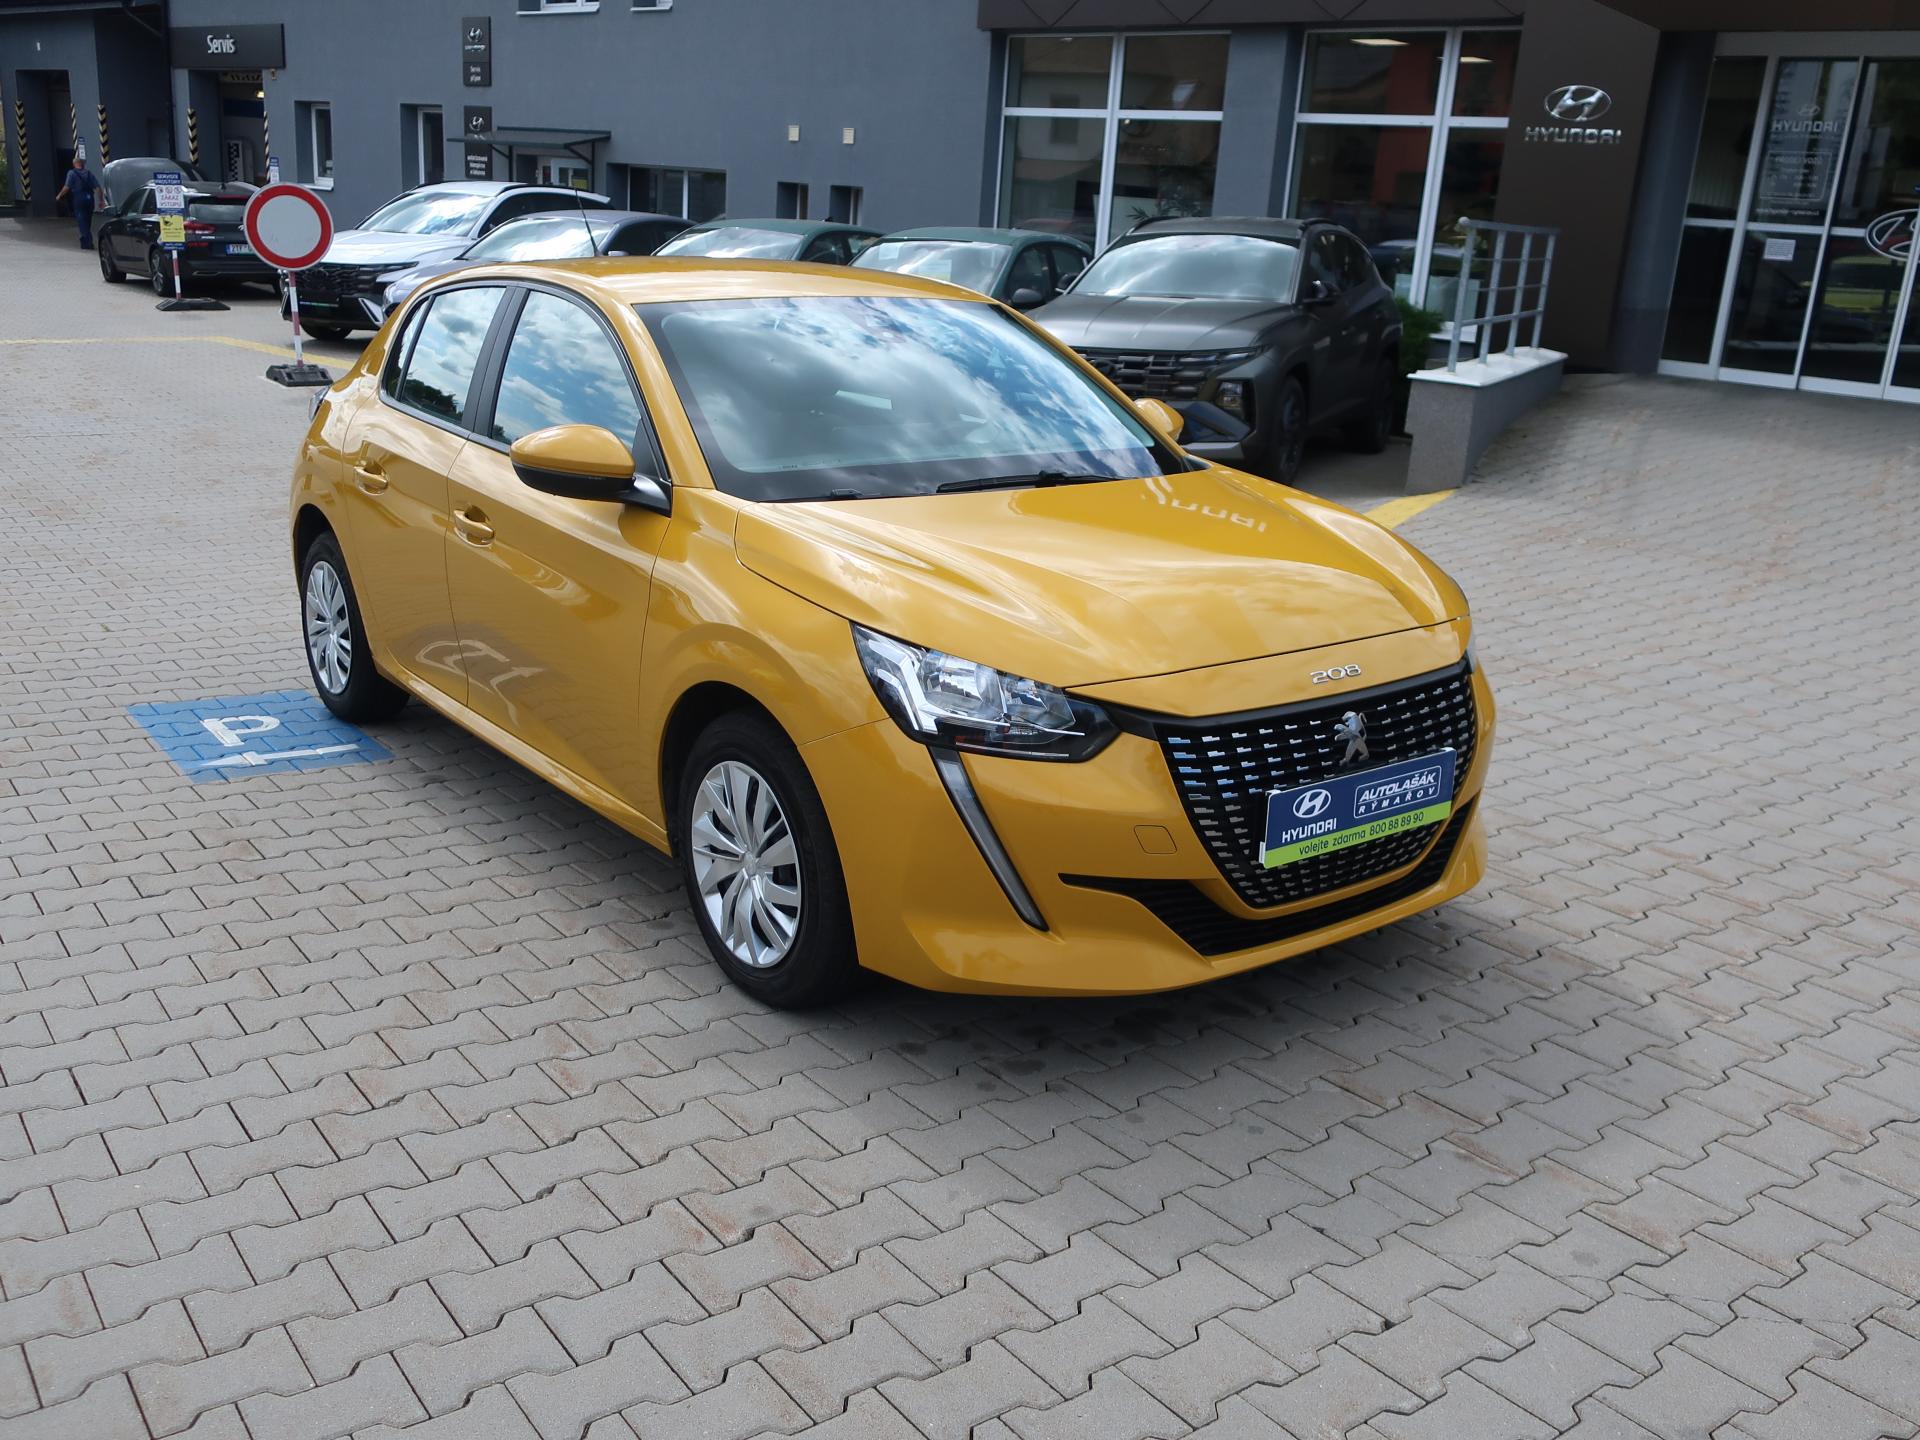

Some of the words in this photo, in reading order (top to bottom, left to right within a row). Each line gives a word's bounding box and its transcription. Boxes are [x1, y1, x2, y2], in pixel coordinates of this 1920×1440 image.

[207, 34, 236, 53] Servis
[1525, 126, 1622, 144] HYUNDAI
[1771, 120, 1838, 132] HYUNDAI
[1310, 664, 1361, 684] 208
[200, 715, 280, 747] P
[1359, 771, 1437, 802] AUTOLAŠÁK
[1281, 817, 1337, 843] HYUNDAI
[1299, 839, 1329, 855] volejte
[1332, 830, 1366, 847] zdarma
[1369, 822, 1387, 836] 800
[1388, 819, 1399, 831] 88
[1400, 815, 1412, 827] 89
[1412, 811, 1424, 824] 90
